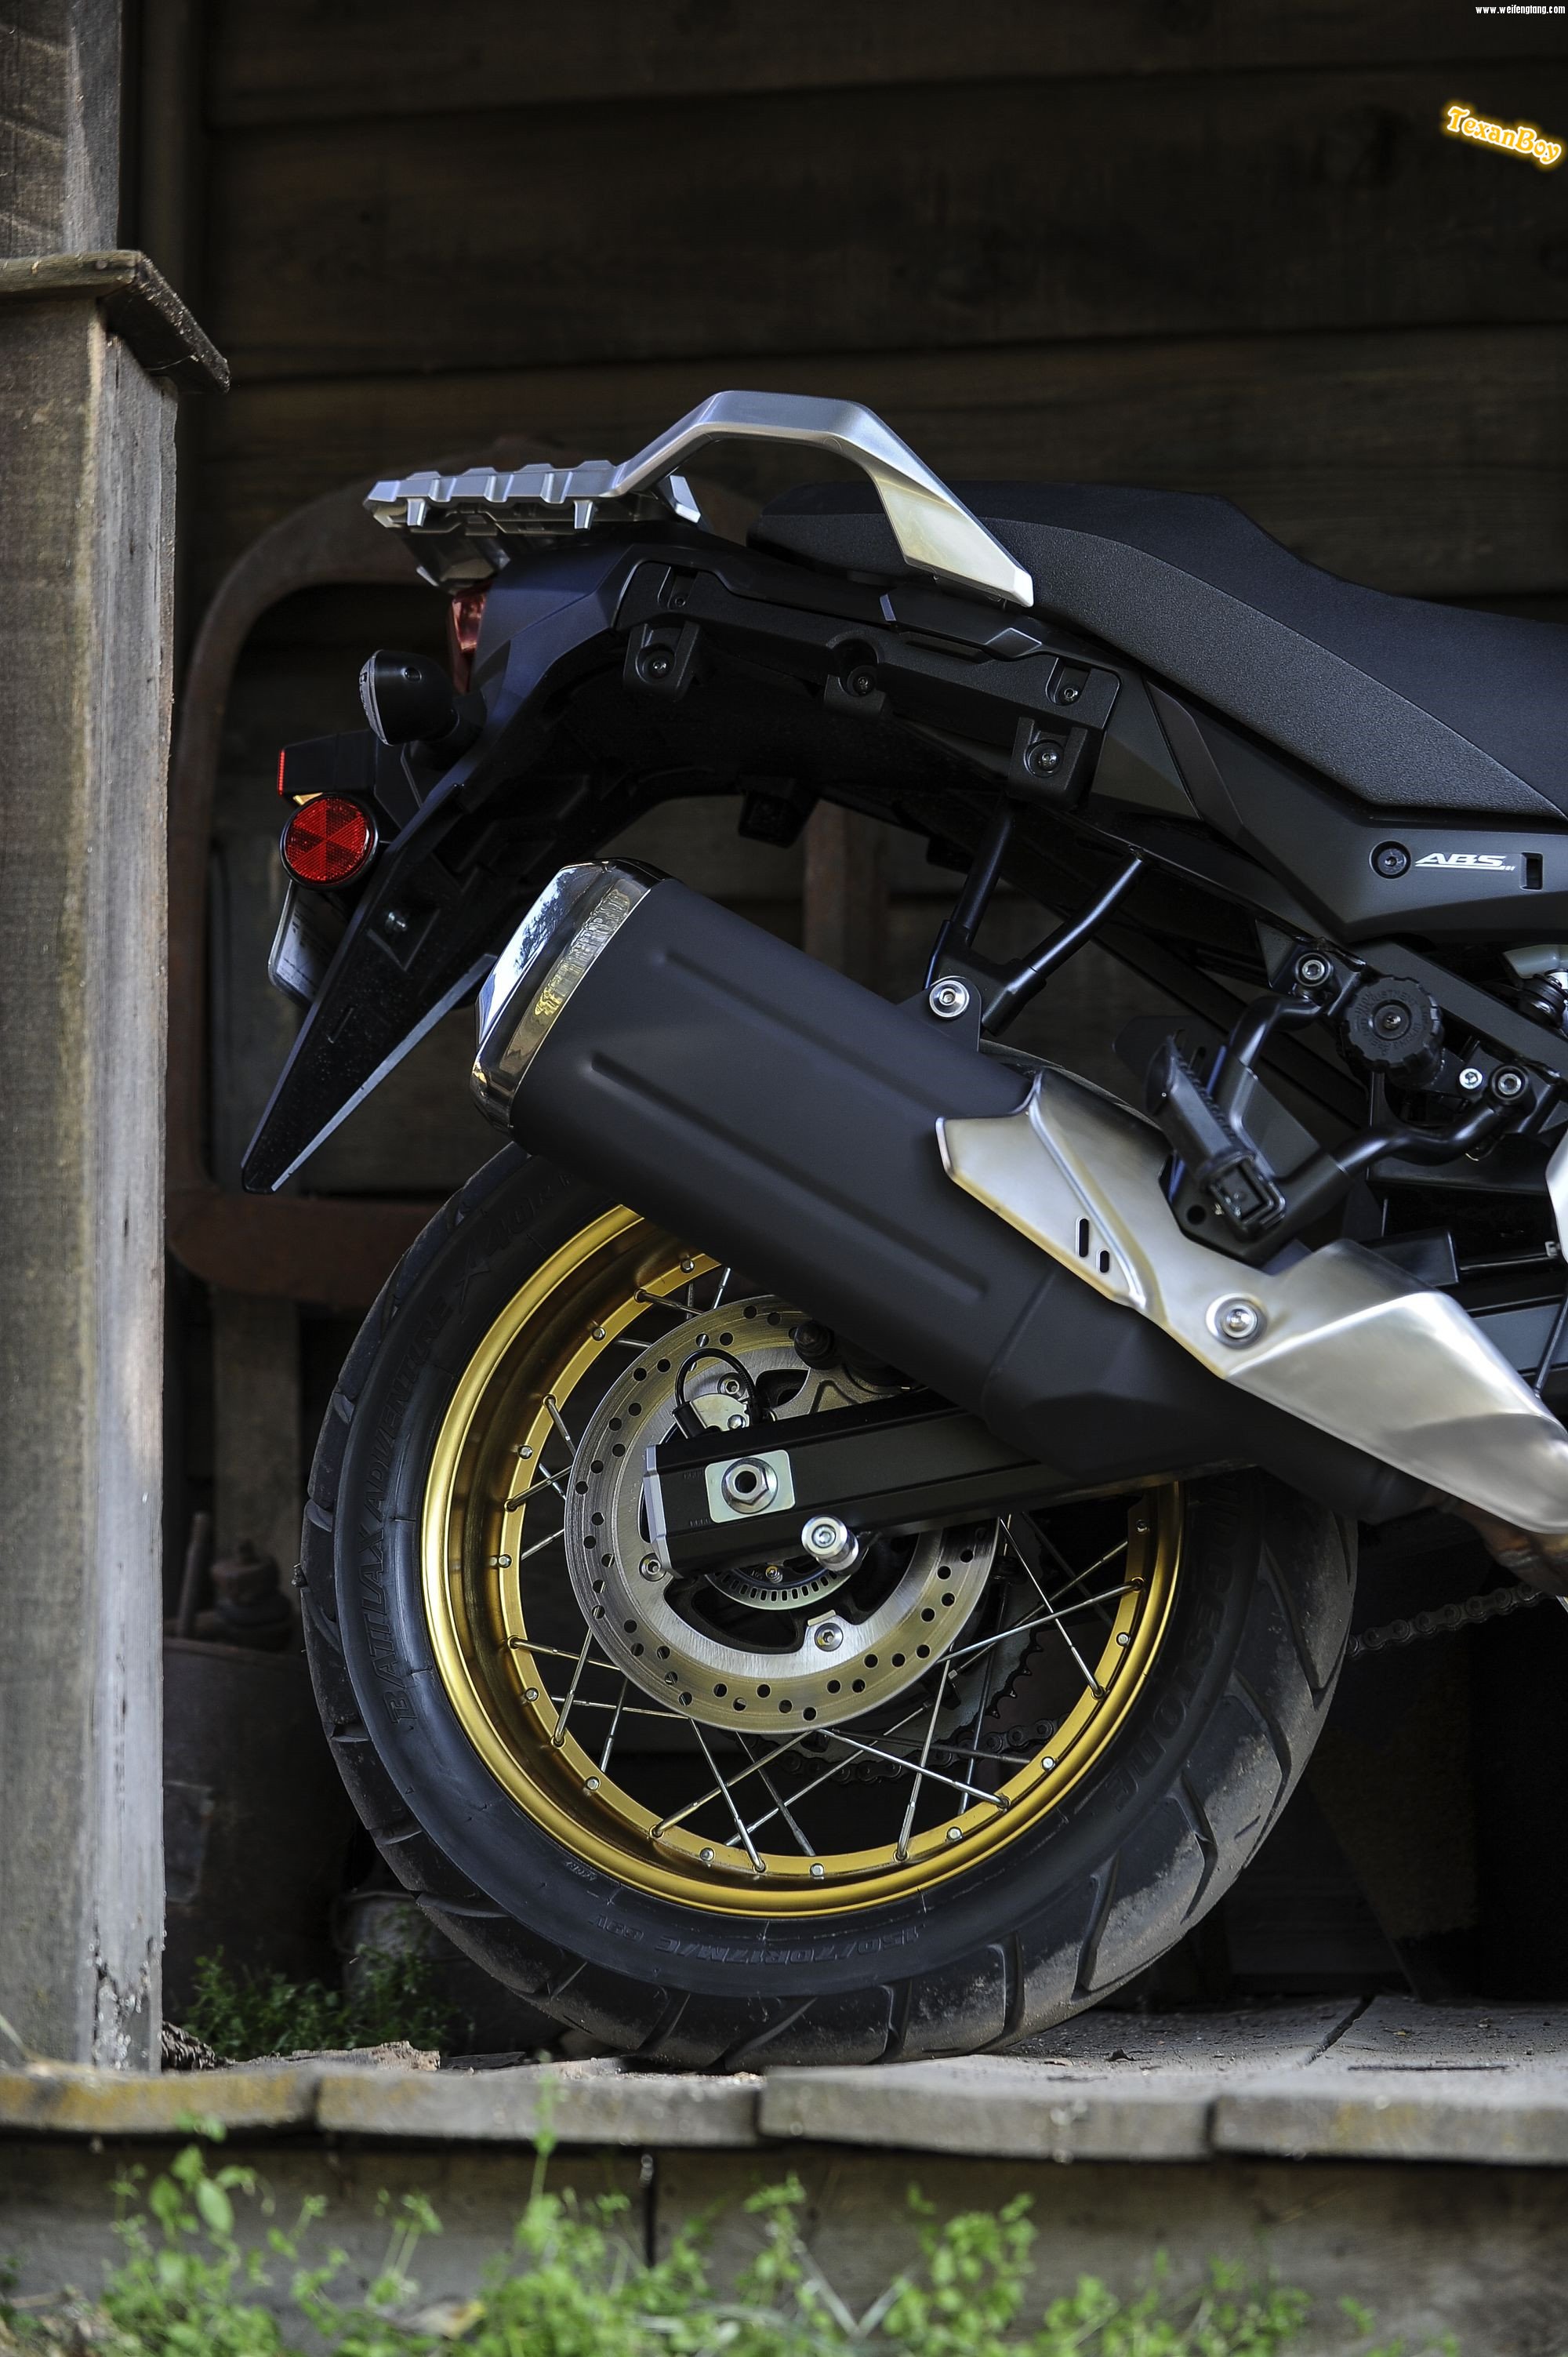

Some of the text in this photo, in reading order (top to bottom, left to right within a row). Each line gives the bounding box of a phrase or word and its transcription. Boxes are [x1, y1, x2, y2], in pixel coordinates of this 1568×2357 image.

[1414, 852, 1508, 866] ABS
[364, 1294, 453, 1522] ADVENTURE
[358, 1523, 419, 1724] BATTLAX
[1105, 1472, 1241, 1813] IDGESTONE
